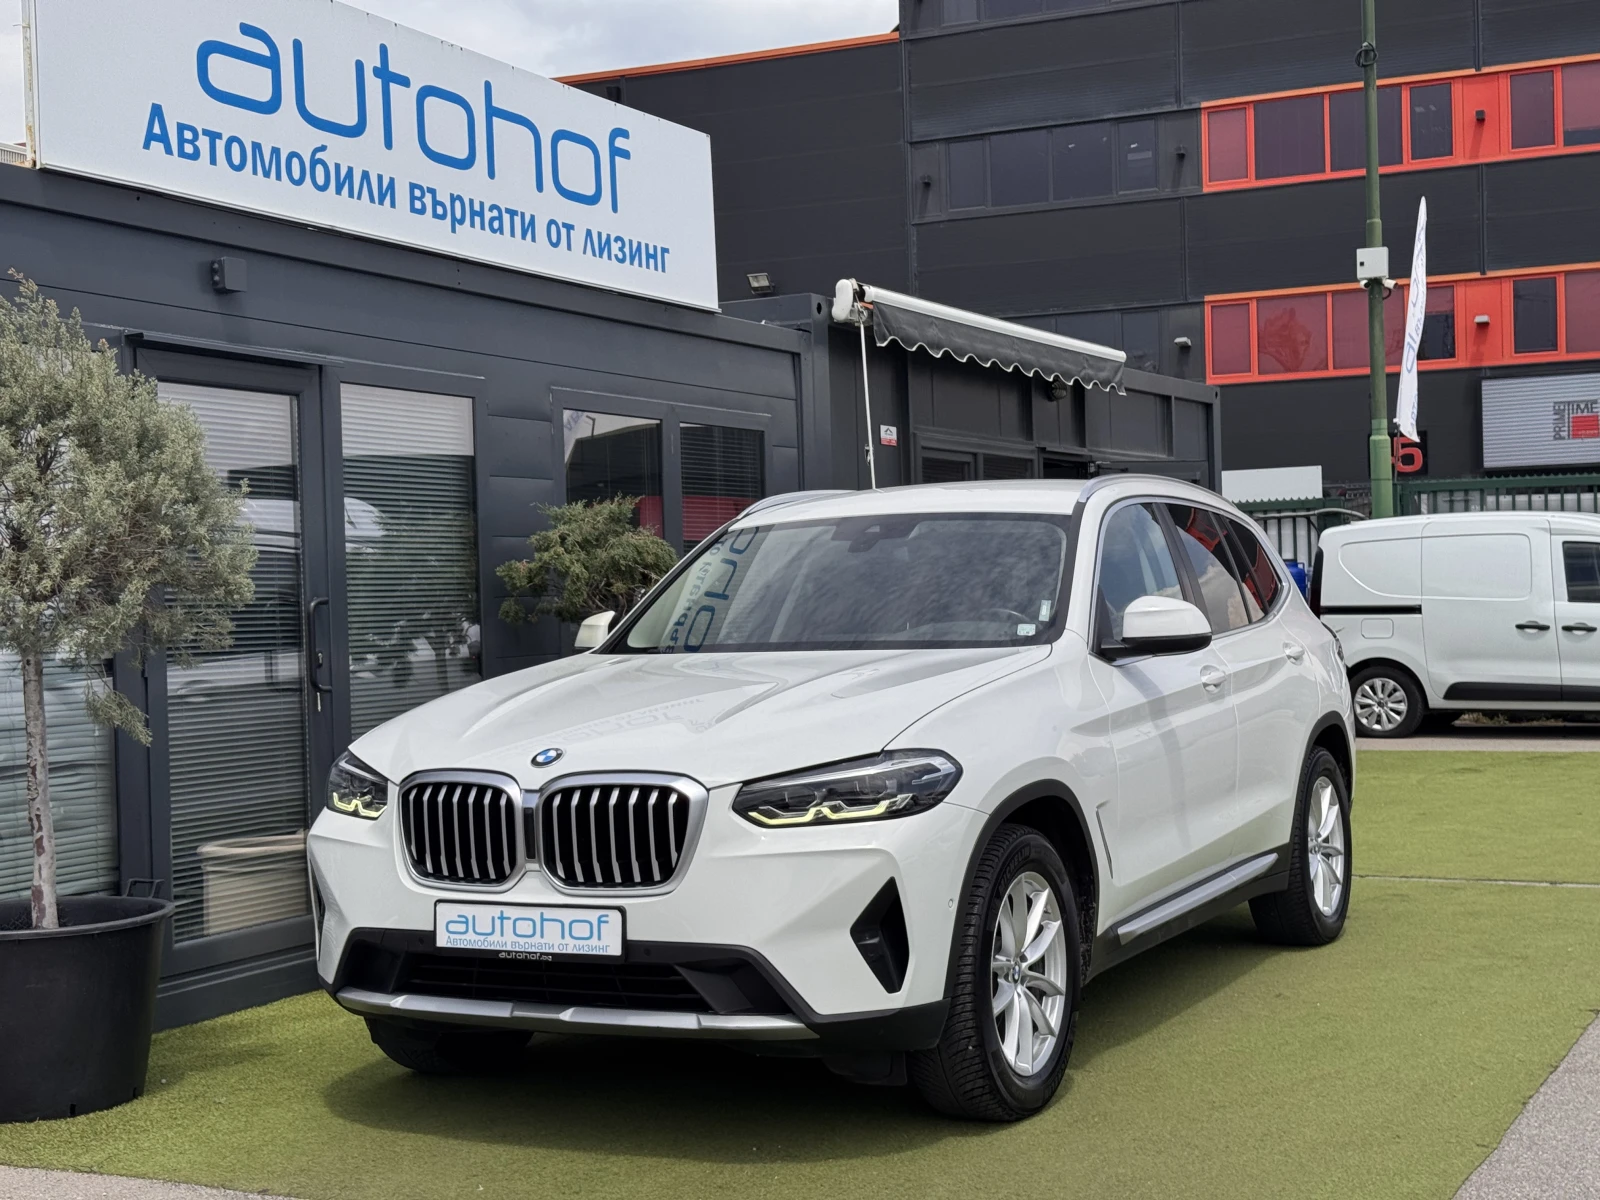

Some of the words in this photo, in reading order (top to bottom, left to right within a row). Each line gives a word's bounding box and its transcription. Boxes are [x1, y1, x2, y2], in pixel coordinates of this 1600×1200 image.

[196, 22, 631, 214] autohof
[142, 103, 397, 209] Автомобили
[409, 182, 537, 243] върнати
[546, 222, 575, 253] от
[583, 229, 670, 274] лизинг
[445, 910, 609, 941] autohof
[445, 935, 508, 949] Автомобили
[510, 941, 555, 953] върнати
[557, 943, 569, 952] от
[572, 944, 611, 954] лизинг
